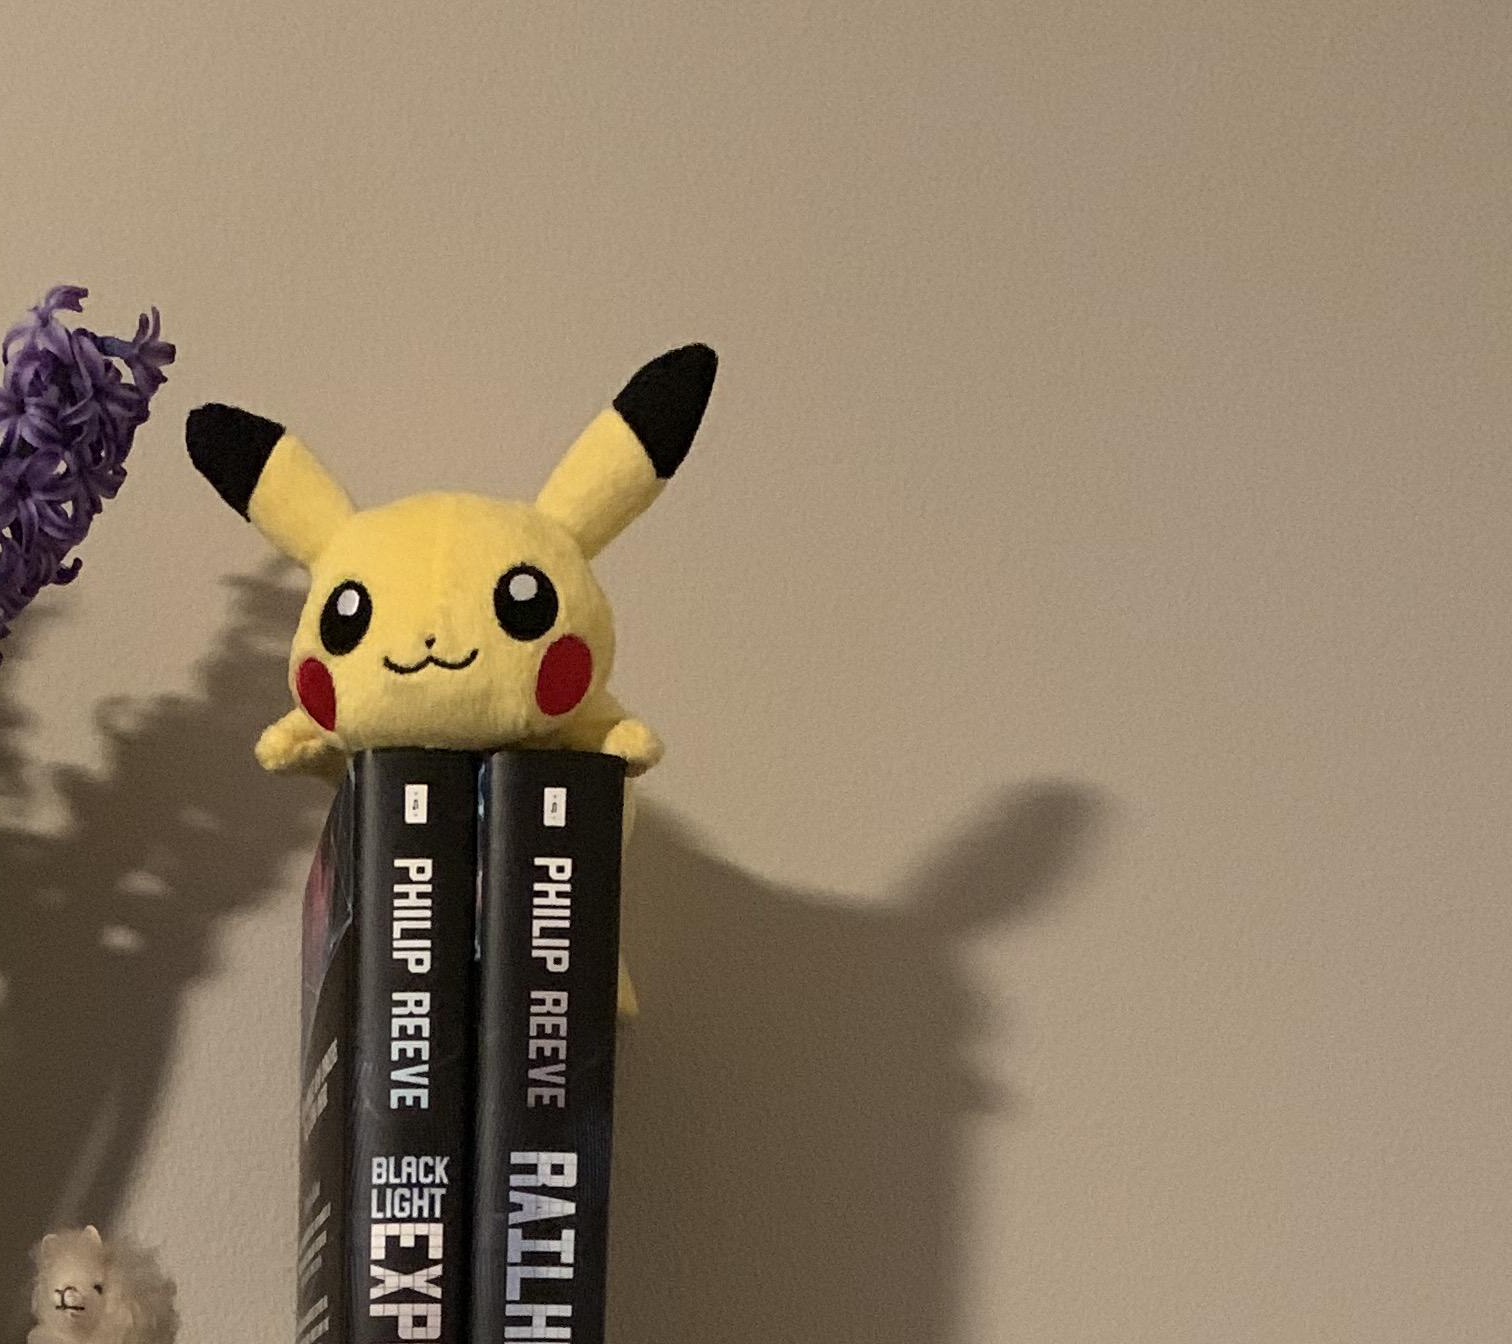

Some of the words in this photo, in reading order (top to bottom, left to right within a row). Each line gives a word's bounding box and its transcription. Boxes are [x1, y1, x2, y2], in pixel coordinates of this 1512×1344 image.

[392, 857, 434, 975] PHILIP
[530, 856, 573, 974] PHILIP
[389, 991, 431, 1110] REEVE
[526, 990, 569, 1109] REEVE
[370, 1187, 447, 1220] LIGHT
[371, 1155, 450, 1187] BLACK
